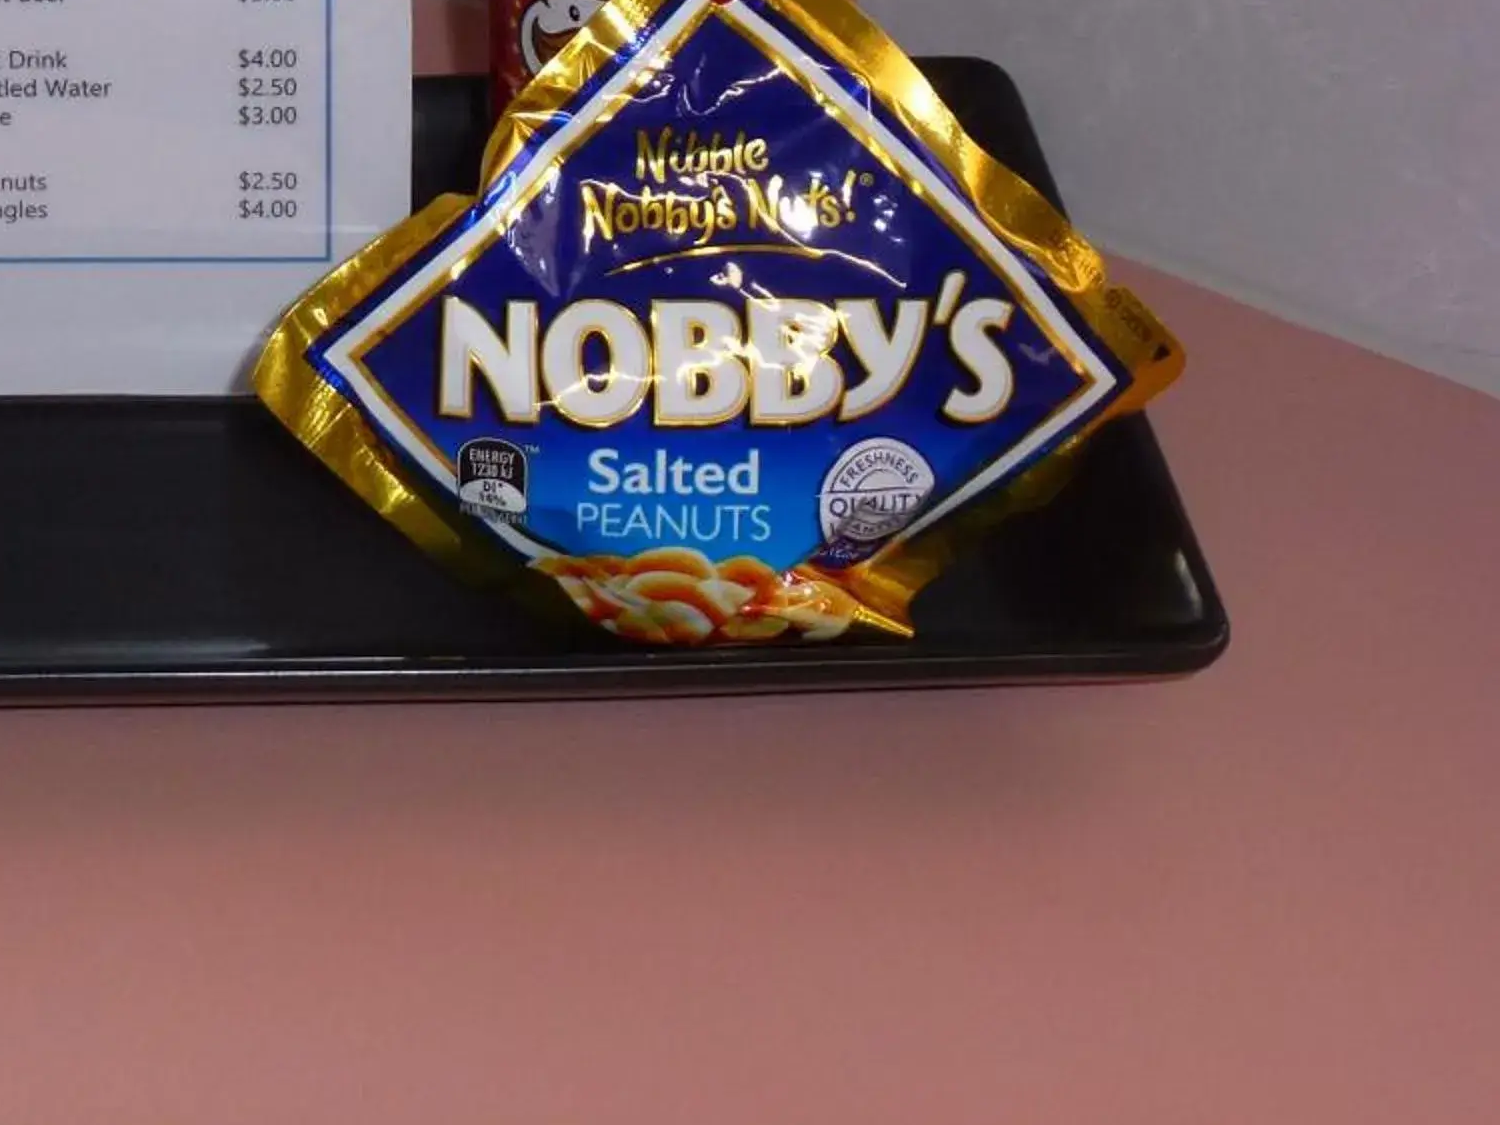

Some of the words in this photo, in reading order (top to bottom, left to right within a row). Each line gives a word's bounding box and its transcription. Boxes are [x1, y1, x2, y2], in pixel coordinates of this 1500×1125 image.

[9, 51, 66, 69] Drink
[239, 49, 296, 69] $4.00
[45, 79, 112, 97] Water
[239, 77, 297, 97] $2.50
[239, 106, 297, 126] $3.00
[635, 127, 770, 183] Nibble
[239, 171, 297, 191] $2.50
[239, 199, 297, 219] $4.00
[582, 182, 738, 253] Nobby's
[438, 271, 1014, 428] NOBBY'S
[469, 448, 515, 466] ENERGY
[587, 450, 759, 494] Salted
[839, 451, 920, 488] FRESHNESS
[577, 504, 770, 541] PEANUTS
